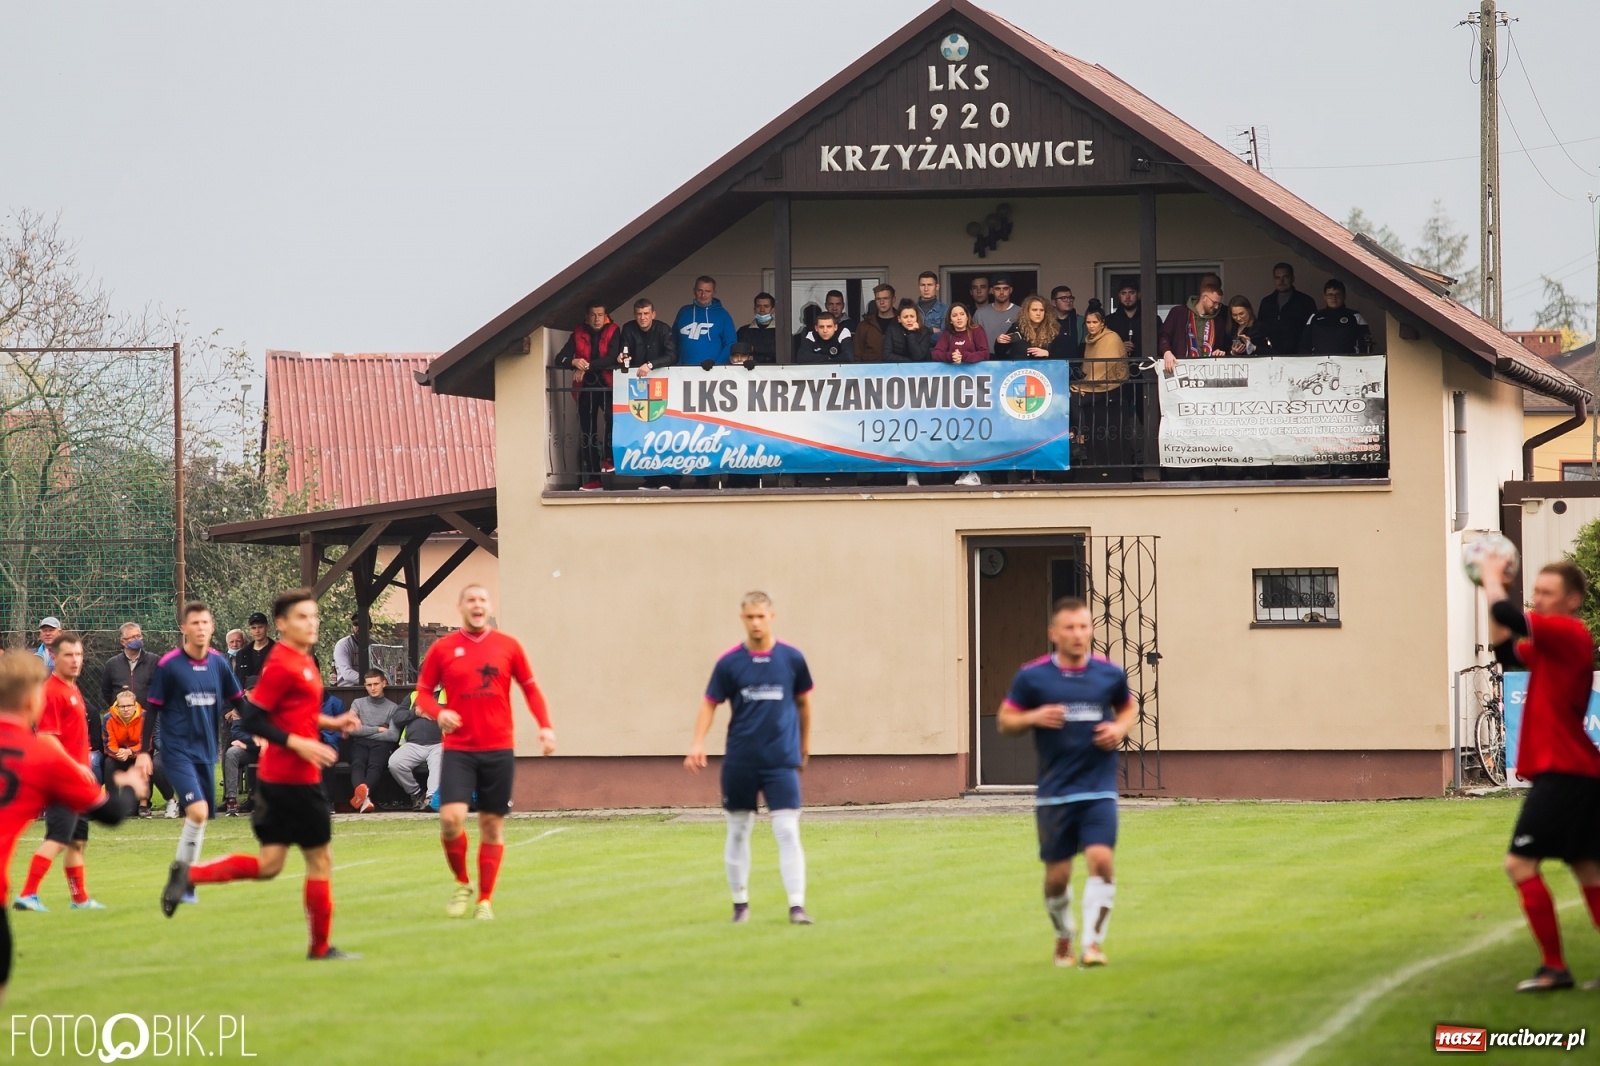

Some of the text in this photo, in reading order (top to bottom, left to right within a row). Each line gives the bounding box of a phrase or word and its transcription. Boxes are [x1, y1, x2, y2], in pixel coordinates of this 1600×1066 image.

[928, 64, 990, 92] LKS
[905, 102, 1010, 130] 1920
[820, 136, 1095, 172] KRZYŻANOWICE
[1189, 364, 1249, 379] KUHN
[1182, 380, 1205, 388] PRD
[683, 372, 993, 413] LKS KRZYŻANOWICE
[1178, 399, 1366, 416] BRUKARSTWO
[1186, 415, 1359, 427] DORADZTWO PROJEKTOWANIE
[858, 417, 993, 443] 1920-2020
[1165, 424, 1379, 437] SPRZEDAŻ KOSTKI W CENACH HURTOWYCH
[1164, 444, 1234, 454] Krzyżanowice
[1314, 454, 1334, 462] 603
[1361, 452, 1382, 462] 412
[621, 444, 783, 475] Naszego Klubu
[1242, 456, 1254, 464] 48
